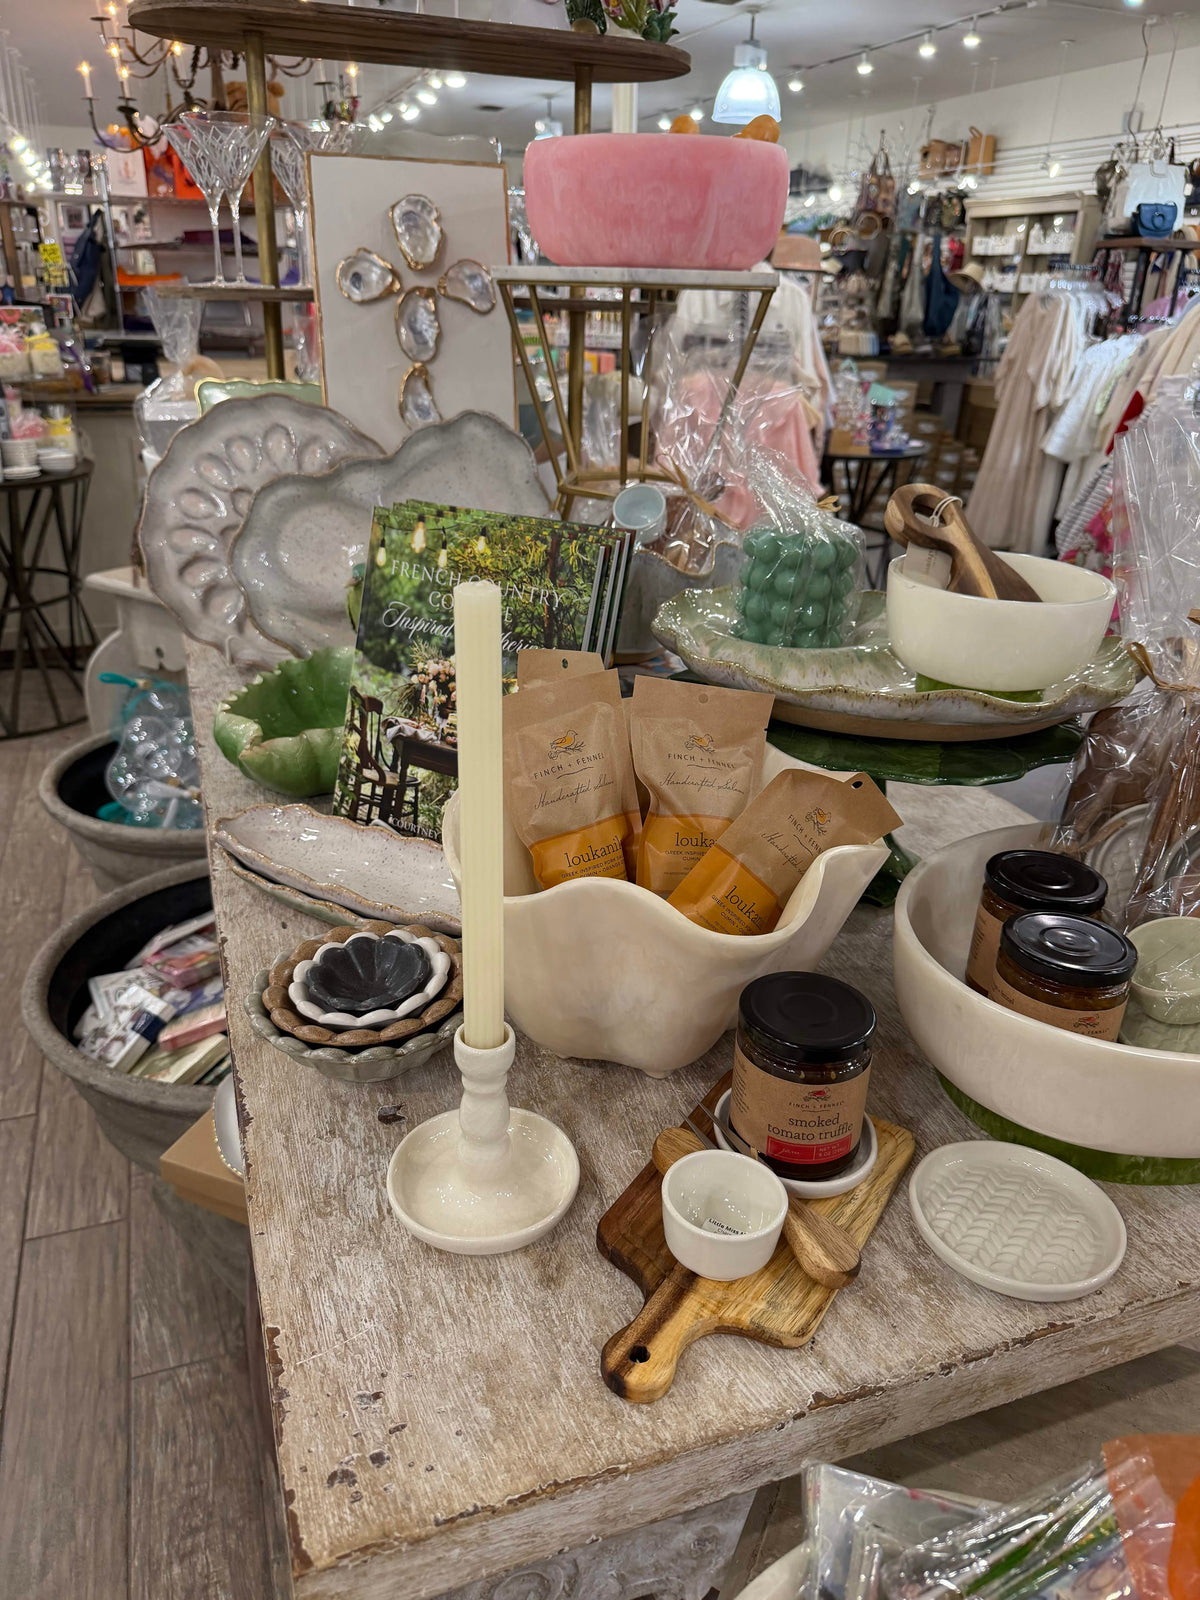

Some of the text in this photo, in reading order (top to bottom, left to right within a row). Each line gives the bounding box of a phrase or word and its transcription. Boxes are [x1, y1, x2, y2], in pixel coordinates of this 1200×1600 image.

[391, 559, 461, 586] FRENCH
[468, 574, 564, 610] UNTRY
[382, 601, 454, 640] Inspired
[667, 753, 695, 762] FINCH
[534, 764, 563, 780] FINCH
[660, 771, 716, 793] Handcrafted
[534, 778, 591, 810] Handcrafted
[787, 813, 804, 834] FINCH
[675, 831, 718, 848] louka
[788, 1112, 840, 1128] smoked
[767, 1121, 854, 1141] tomato truffle
[708, 1218, 725, 1229] Little
